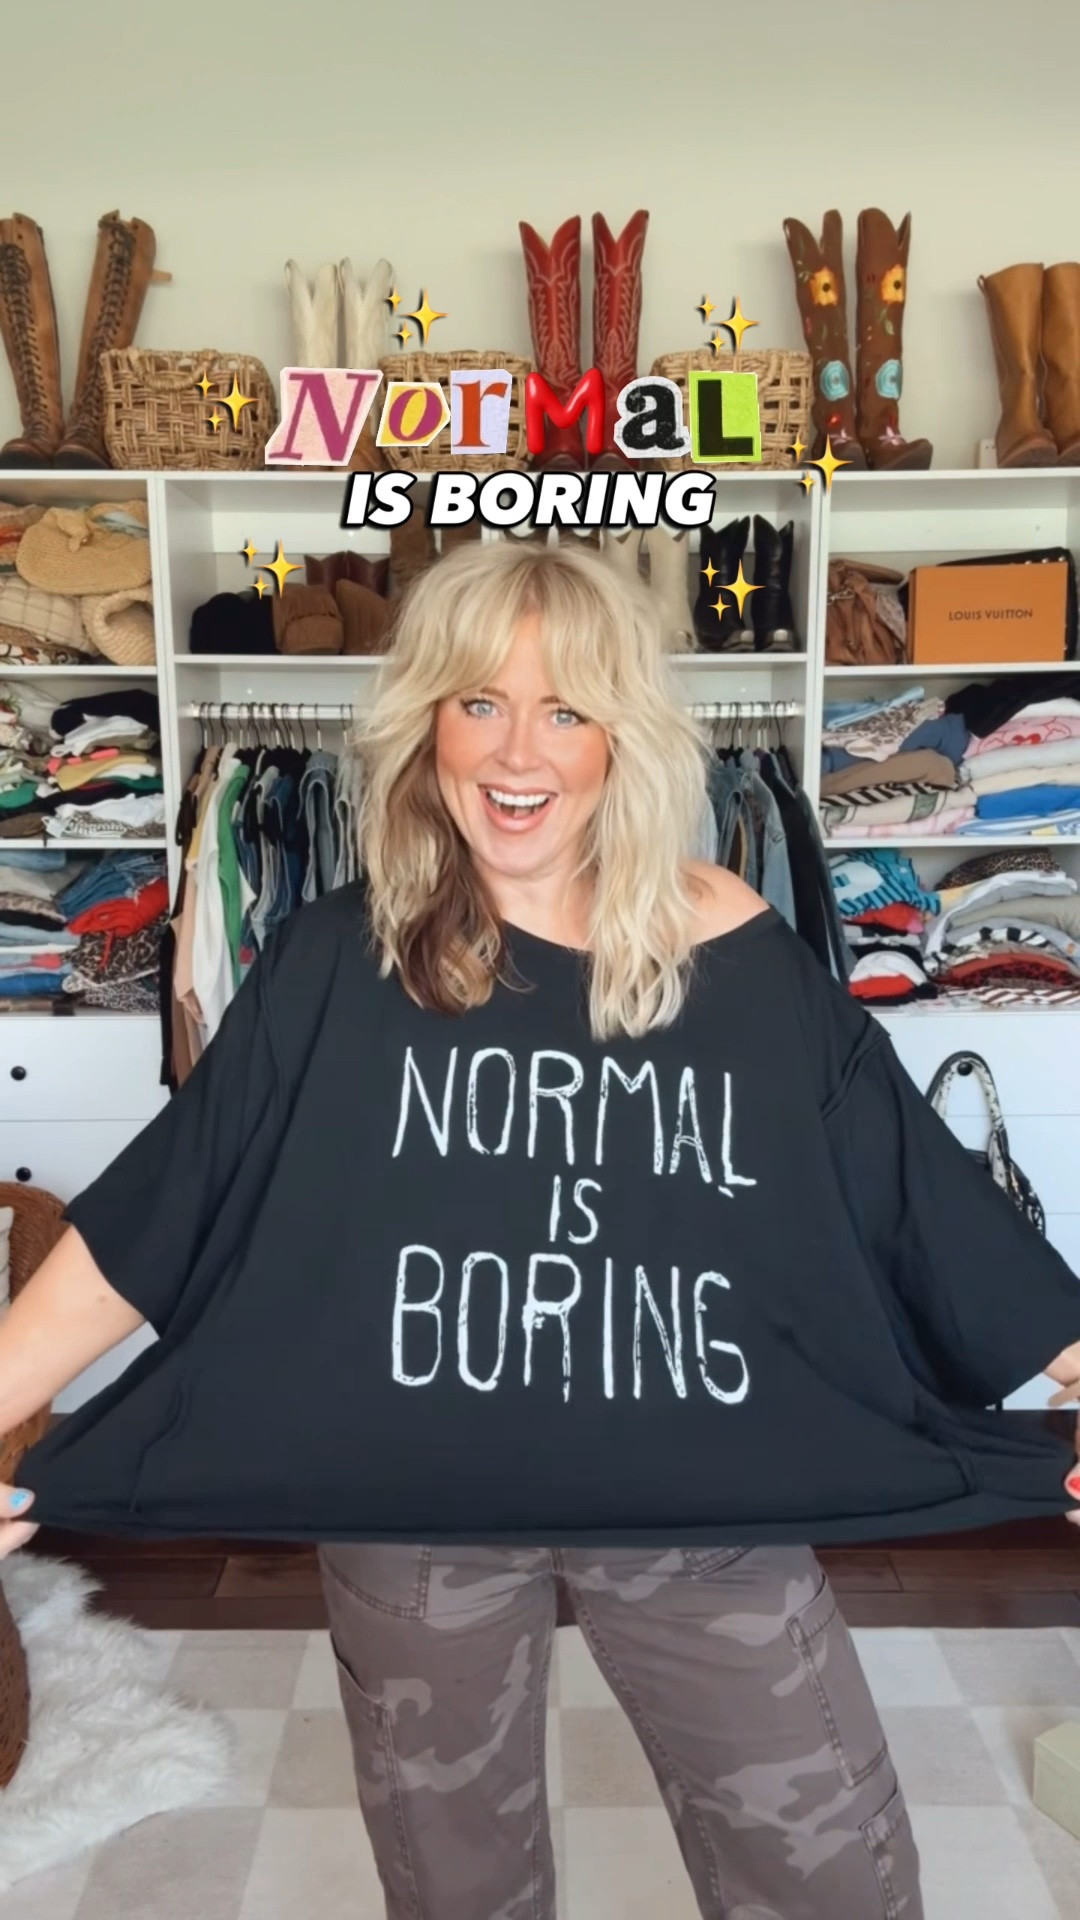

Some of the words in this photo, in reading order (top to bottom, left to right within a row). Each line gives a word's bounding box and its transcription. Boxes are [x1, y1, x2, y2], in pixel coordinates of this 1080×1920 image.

[948, 609, 982, 622] LOUIS
[985, 608, 1033, 620] VUITTON
[391, 1046, 757, 1188] NORMAL
[548, 1175, 602, 1244] IS
[391, 1244, 749, 1404] BORING
